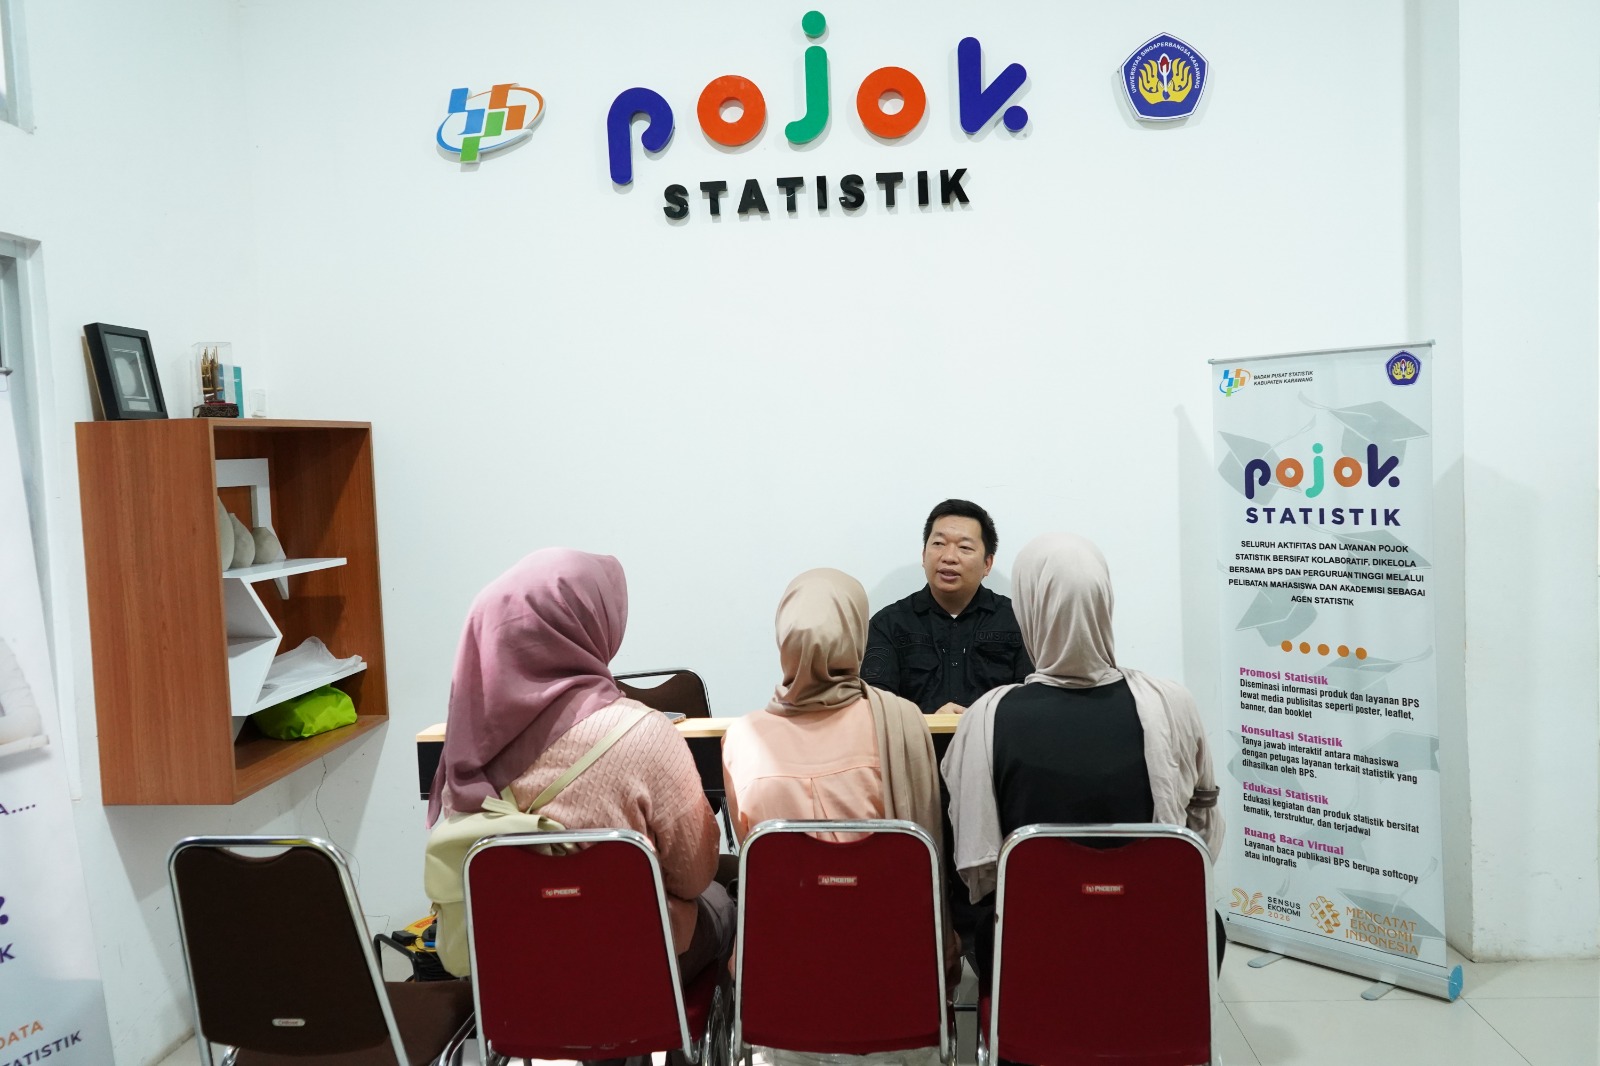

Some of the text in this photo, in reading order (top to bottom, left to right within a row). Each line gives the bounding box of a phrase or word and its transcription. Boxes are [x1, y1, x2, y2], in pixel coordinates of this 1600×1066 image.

[1130, 42, 1201, 94] UNIVERSITAS SINGAPERBANGSA KARAWANG
[663, 168, 971, 219] STATISTIK
[1284, 376, 1313, 384] KARAWANG
[1288, 370, 1314, 378] STATISTIK
[1246, 507, 1401, 526] STATISTIK
[1240, 540, 1408, 552] SELURUH AKTIFITAS DAN LAYANAN POJOK
[1236, 553, 1416, 568] STATISTIK BERSIFAT KOLABORATIF, DIKELOLA
[1229, 566, 1266, 574] BERSAMA
[1285, 568, 1301, 576] DAN
[1303, 570, 1352, 578] PERGURUAN
[1354, 572, 1384, 580] TINGGI
[1386, 573, 1424, 582] MELALUI
[1228, 578, 1426, 596] PELIBATAN MAHASISWA DAN AKADEMISI SEBAGAI
[1290, 595, 1354, 606] AGEN STATISTIK
[1240, 667, 1328, 685] Promosi Statistik
[1240, 678, 1420, 708] Diseminasi informasi produk dan layanan BPS
[1240, 690, 1414, 721] lewat media publisitas seperti poster, leaflet,
[1240, 701, 1312, 718] banner, dan booklet
[1242, 724, 1342, 747] Konsultasi Statistik
[1242, 736, 1398, 768] Tanya jawab interaktif antara mahasiswa
[1242, 748, 1418, 784] dengan petugas layanan terkait statistik yang
[1242, 759, 1317, 778] dihasilkan oleh BPS.
[1243, 782, 1328, 805] Edukasi Statistik
[1244, 793, 1420, 834] Edukasi kegiatan dan produk statistik bersifat
[1244, 804, 1370, 836] tematik, terstruktur, dan terjadwal
[1244, 826, 1344, 855] Ruang Baca Virtual
[1244, 850, 1297, 868] atau infografis
[1244, 838, 1418, 884] Layanan baca publikasi BPS berupa softcopy
[1268, 896, 1300, 910] SENSUS
[1268, 904, 1300, 917] EKONOMI
[1268, 910, 1291, 922] 2026
[1346, 906, 1417, 932] MENCATAT
[1350, 918, 1413, 942] EKONOMI
[1346, 929, 1419, 956] INDONESIA
[2, 1030, 82, 1066] ATISTIK
